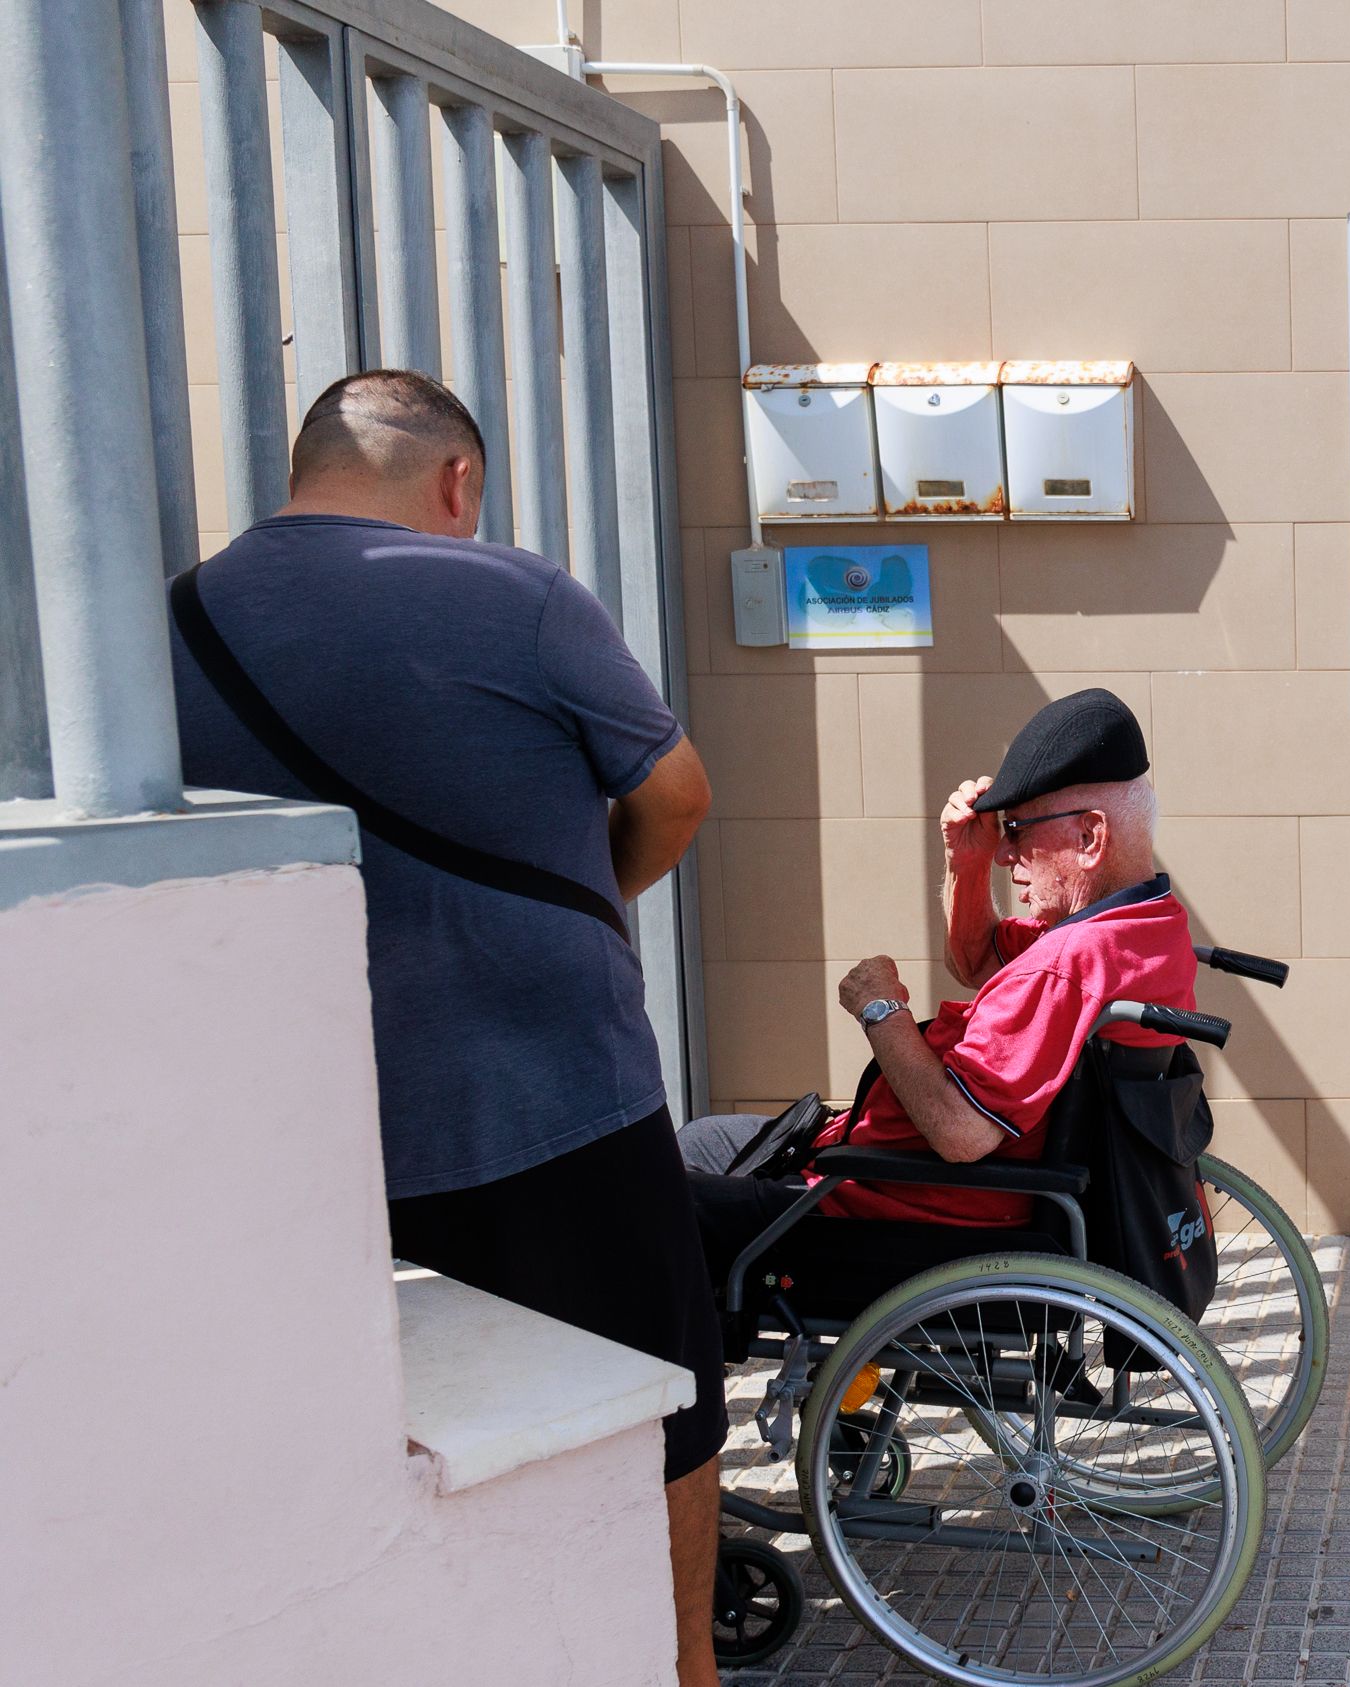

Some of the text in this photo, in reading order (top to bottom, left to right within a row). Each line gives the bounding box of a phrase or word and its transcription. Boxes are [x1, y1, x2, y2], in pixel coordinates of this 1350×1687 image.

[806, 595, 914, 605] ASOCIACIÓN DE JUBILADOS
